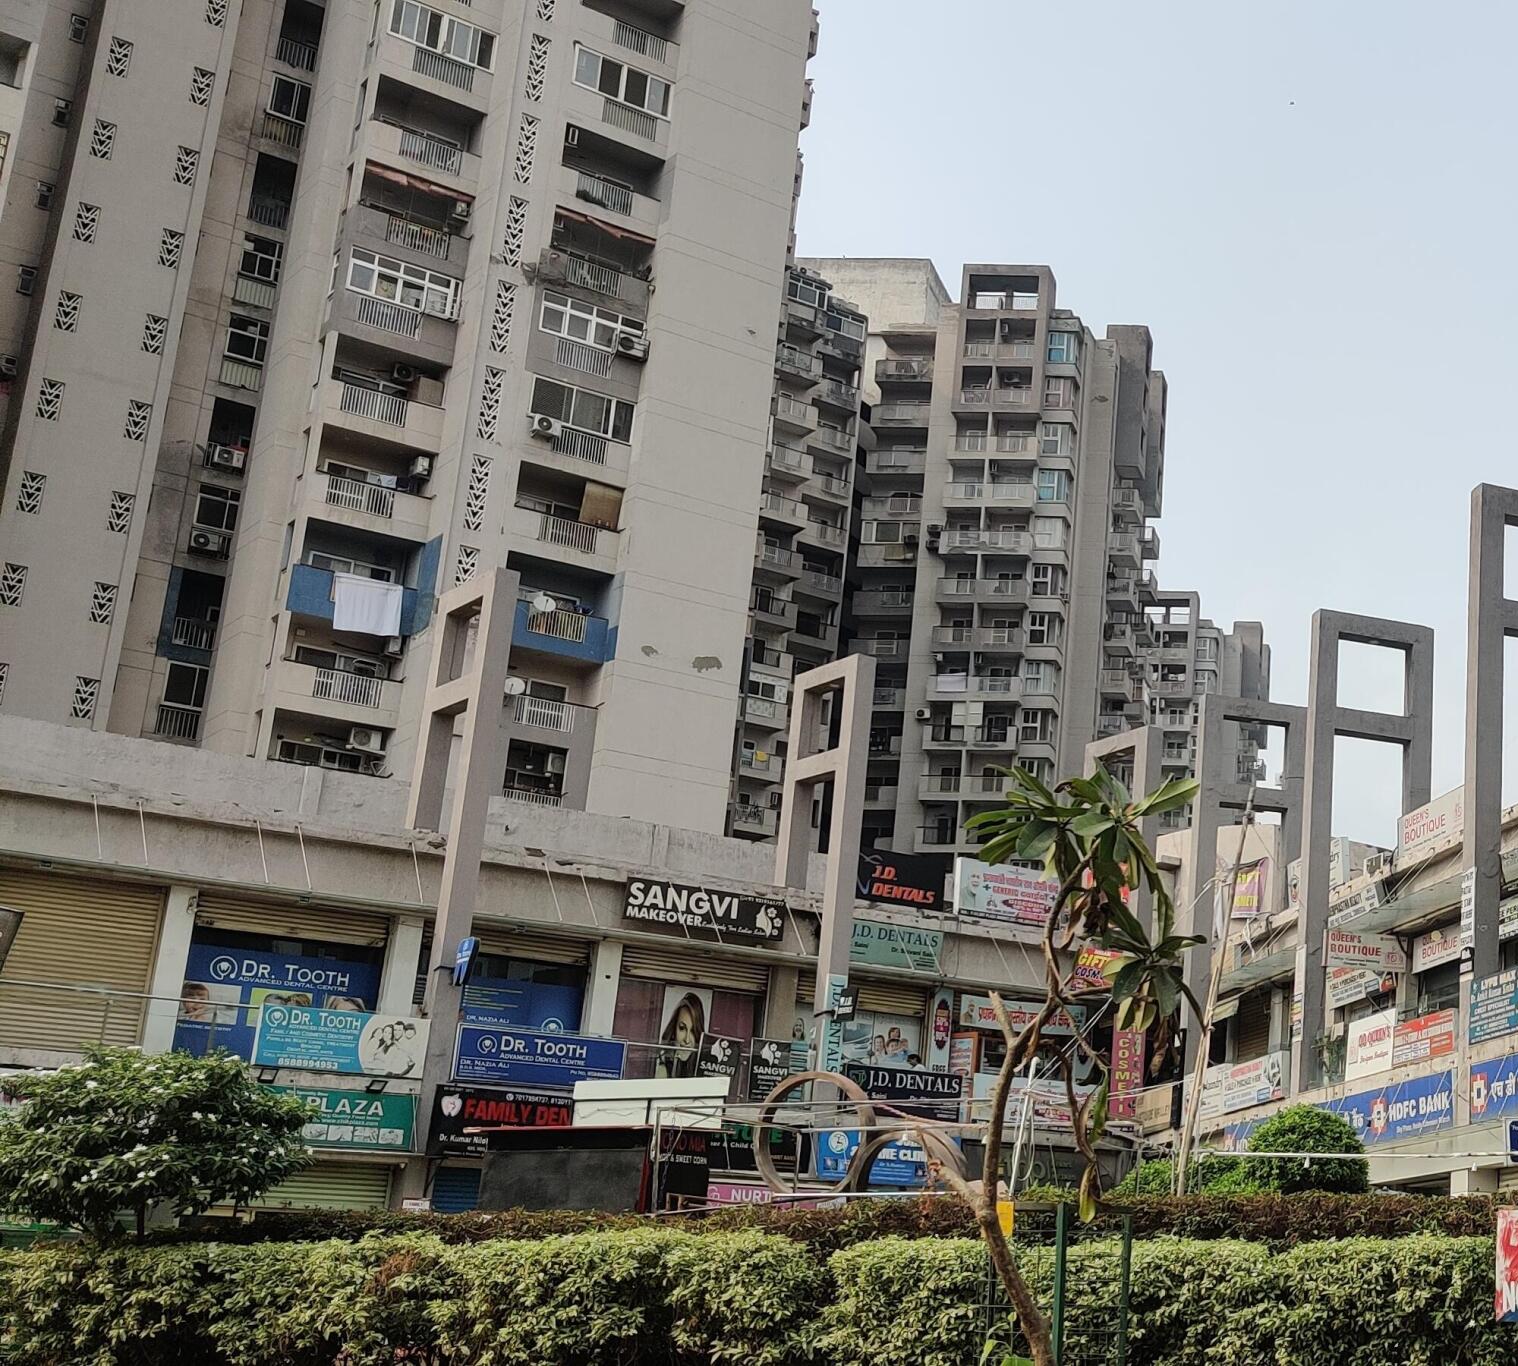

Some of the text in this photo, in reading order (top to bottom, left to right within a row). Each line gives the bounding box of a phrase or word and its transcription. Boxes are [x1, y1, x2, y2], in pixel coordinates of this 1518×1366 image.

[1405, 814, 1445, 844] BOUTIQUE
[628, 882, 740, 920] SANGVI
[872, 883, 935, 903] DENTALS
[626, 906, 702, 928] MAKEOVER
[851, 924, 938, 948] J.D. DENTALS
[1330, 943, 1382, 957] BOUTIQUE
[1422, 936, 1458, 959] BOUTIQUE
[241, 959, 350, 986] DR. TOOTH
[238, 976, 349, 992] ADVANCED DENTAL CENTRE
[290, 1010, 361, 1030] DR. TOOTH
[501, 1035, 587, 1058] DR. TOOTH
[500, 1053, 586, 1066] ADVANCED DENTAL CENTRE
[700, 1061, 735, 1075] SANGVI
[753, 1065, 788, 1076] SANGVI
[868, 1070, 960, 1093] J.D. DENTALS
[306, 1096, 384, 1116] PLAZA
[464, 1097, 532, 1123] FAMILY
[1389, 1090, 1450, 1122] HDFC BANK
